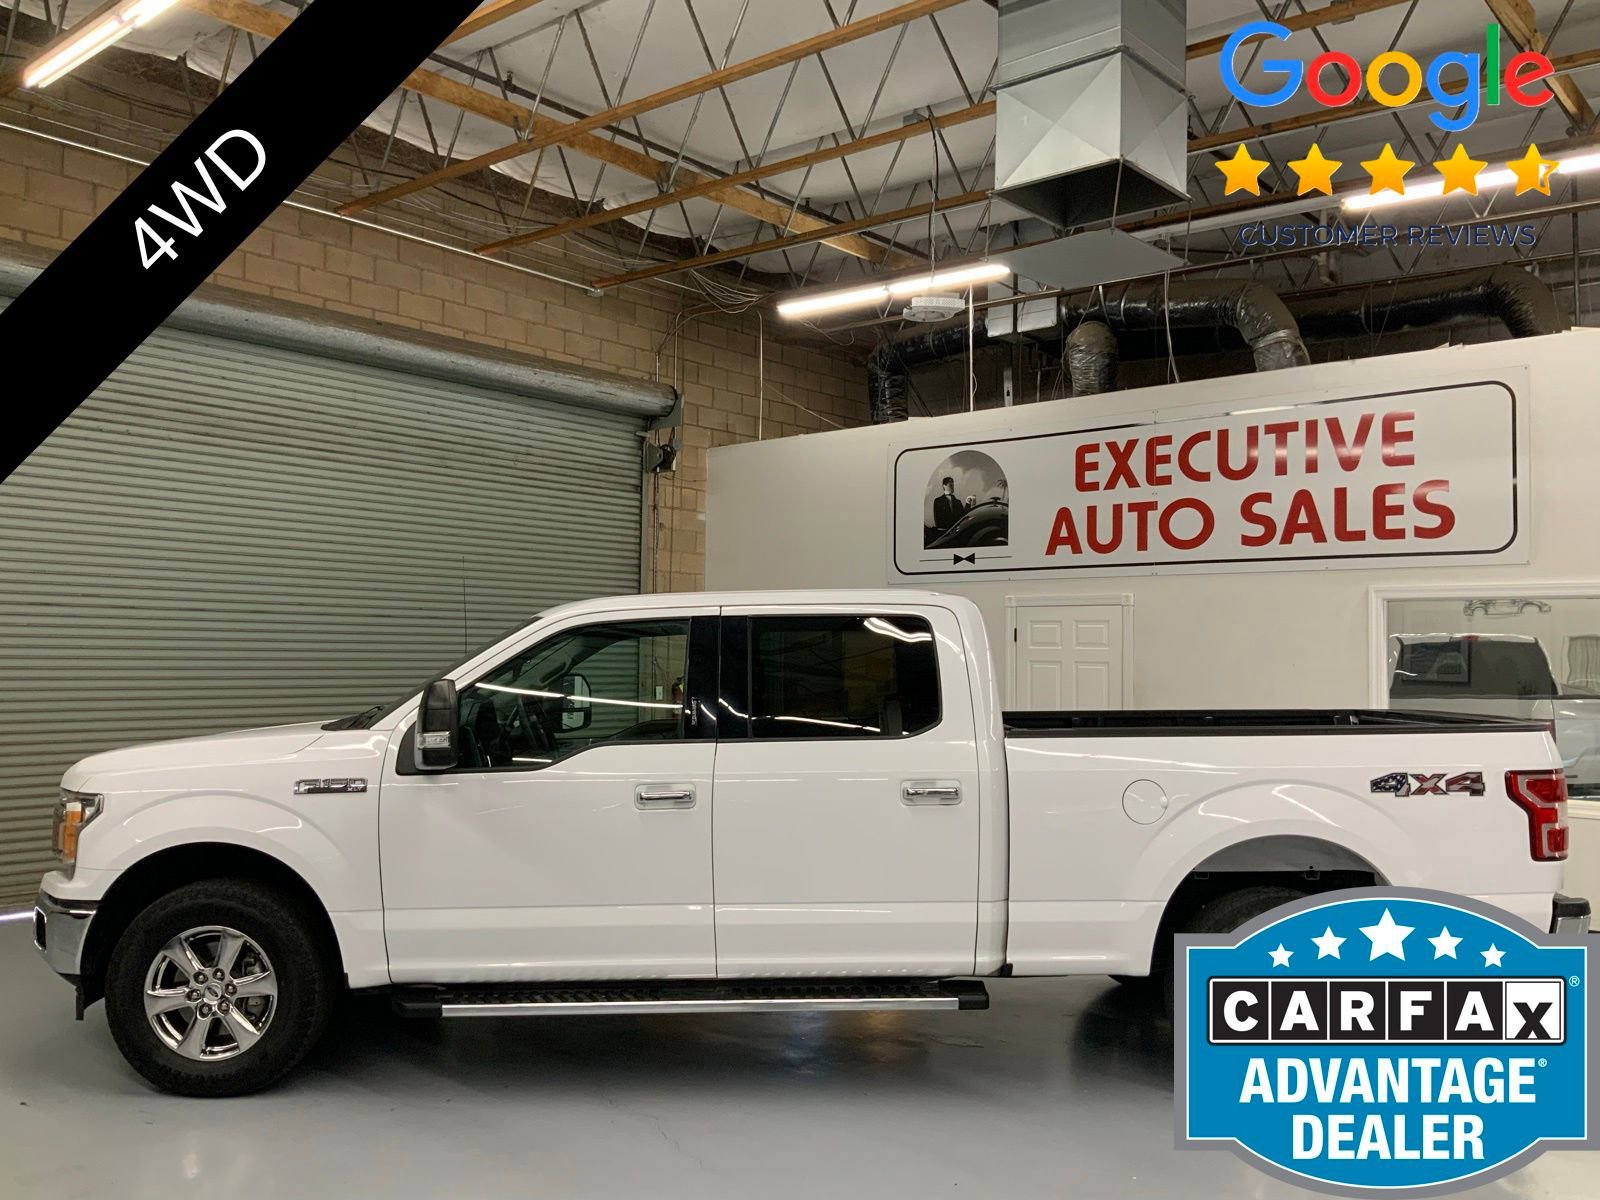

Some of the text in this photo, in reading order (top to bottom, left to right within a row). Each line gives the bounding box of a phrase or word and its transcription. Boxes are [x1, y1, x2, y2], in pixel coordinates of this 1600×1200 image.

[1074, 411, 1416, 493] EXECUTIVE
[1045, 479, 1456, 557] AUTO SALES
